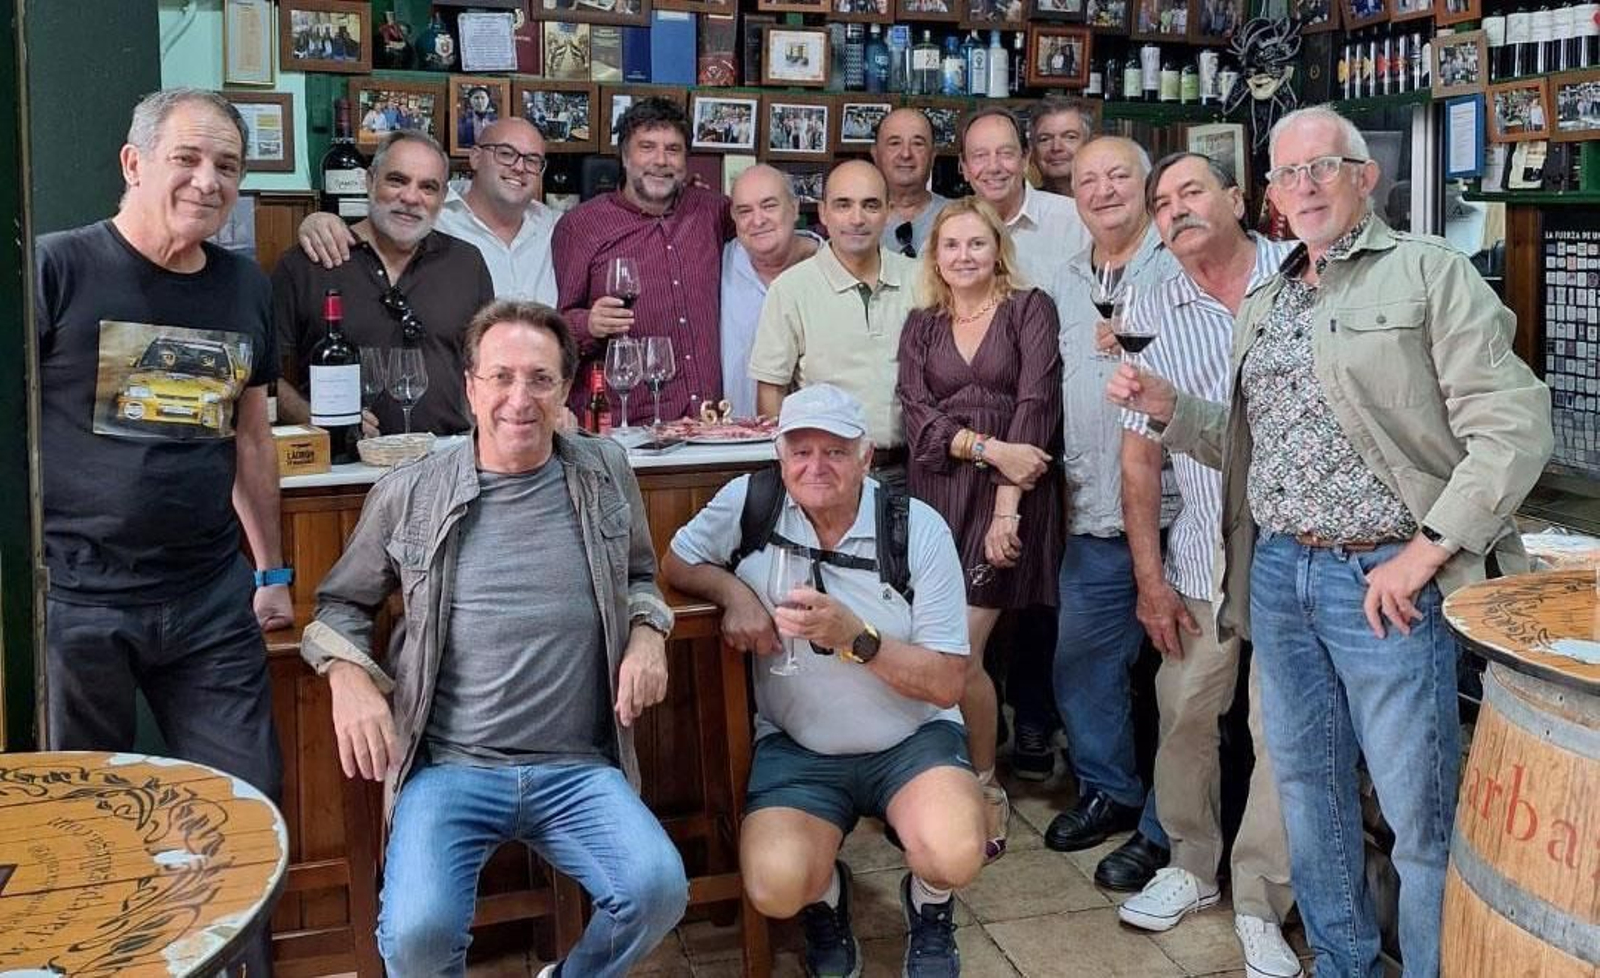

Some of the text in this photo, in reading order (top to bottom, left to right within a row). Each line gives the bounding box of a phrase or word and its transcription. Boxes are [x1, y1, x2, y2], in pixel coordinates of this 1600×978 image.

[1545, 231, 1553, 239] LA
[1555, 231, 1580, 239] FUERZA
[1582, 231, 1591, 240] DE
[1467, 764, 1600, 888] arba
